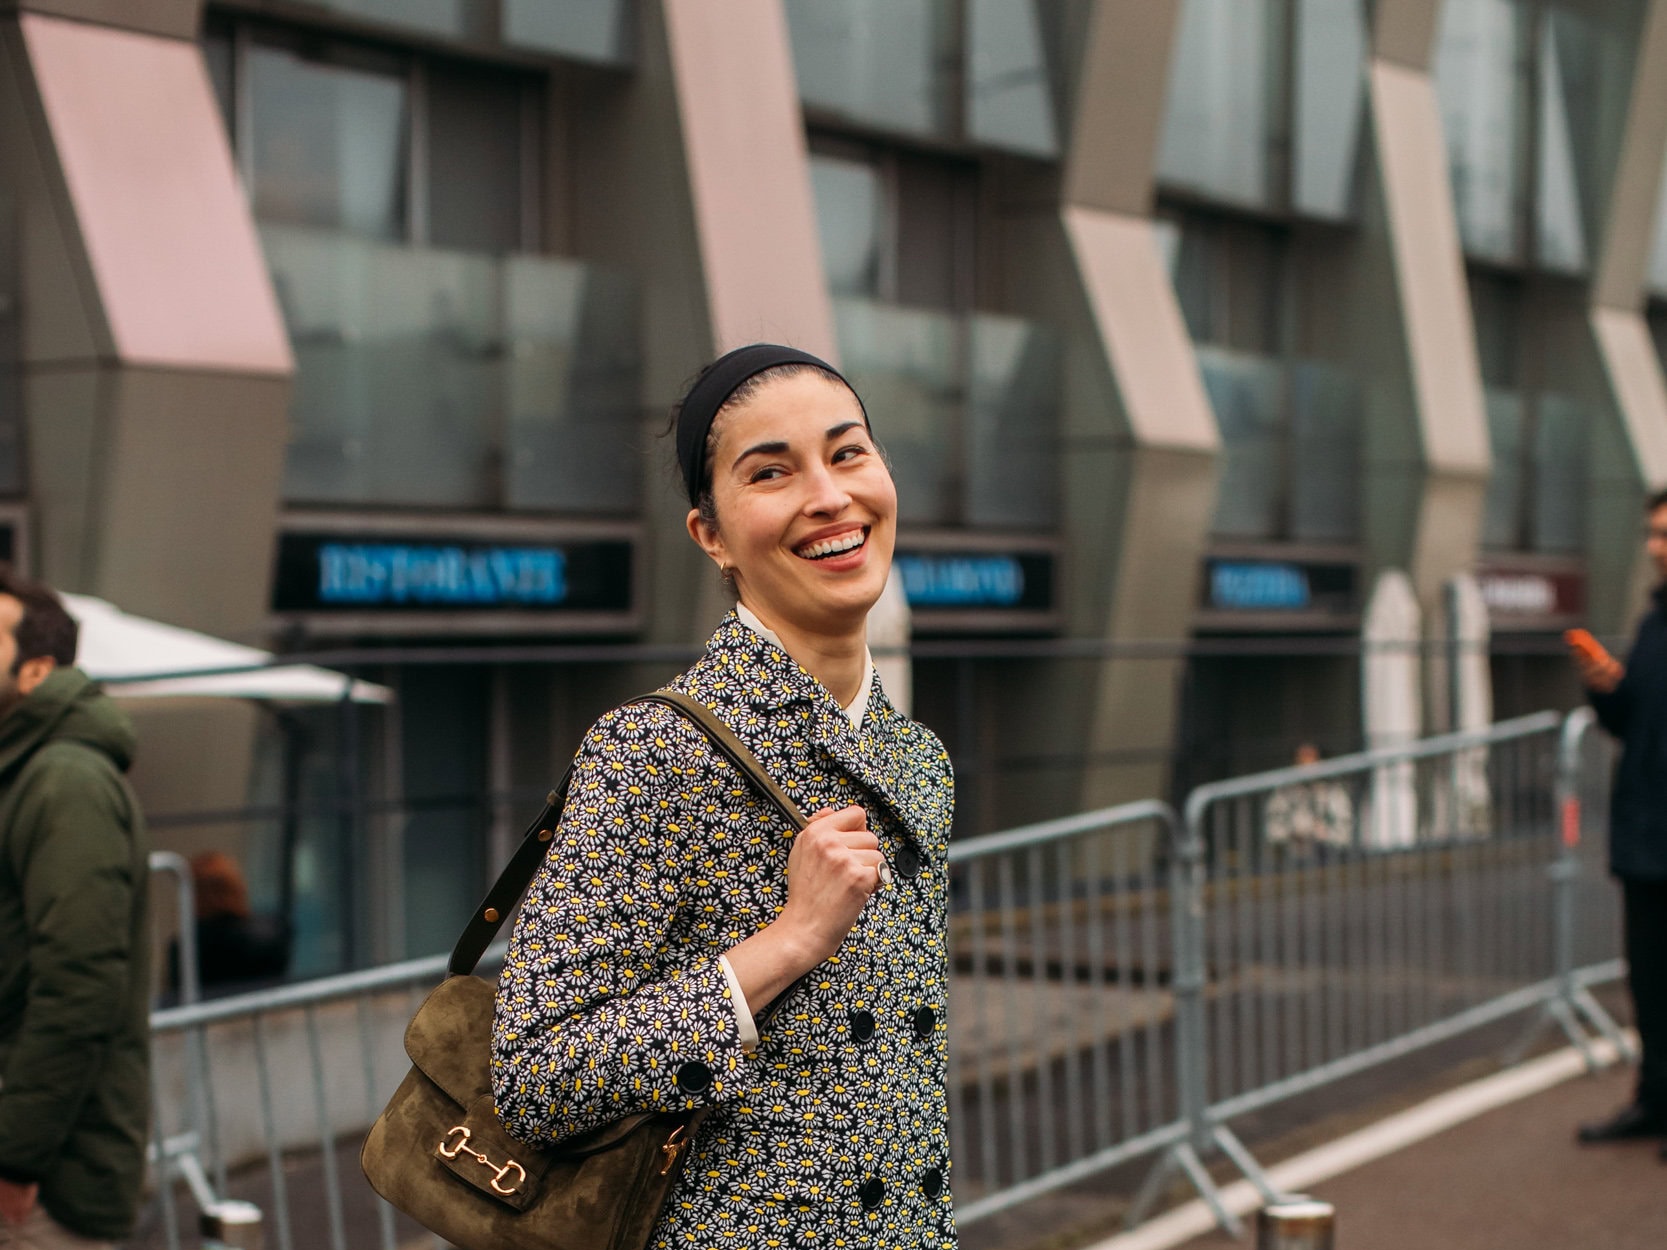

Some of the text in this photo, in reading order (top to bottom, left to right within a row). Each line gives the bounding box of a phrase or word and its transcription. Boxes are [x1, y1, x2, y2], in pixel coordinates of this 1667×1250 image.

[650, 775, 680, 795] GUCCI
[732, 820, 757, 846] GUCCI
[538, 917, 569, 938] GUCCI
